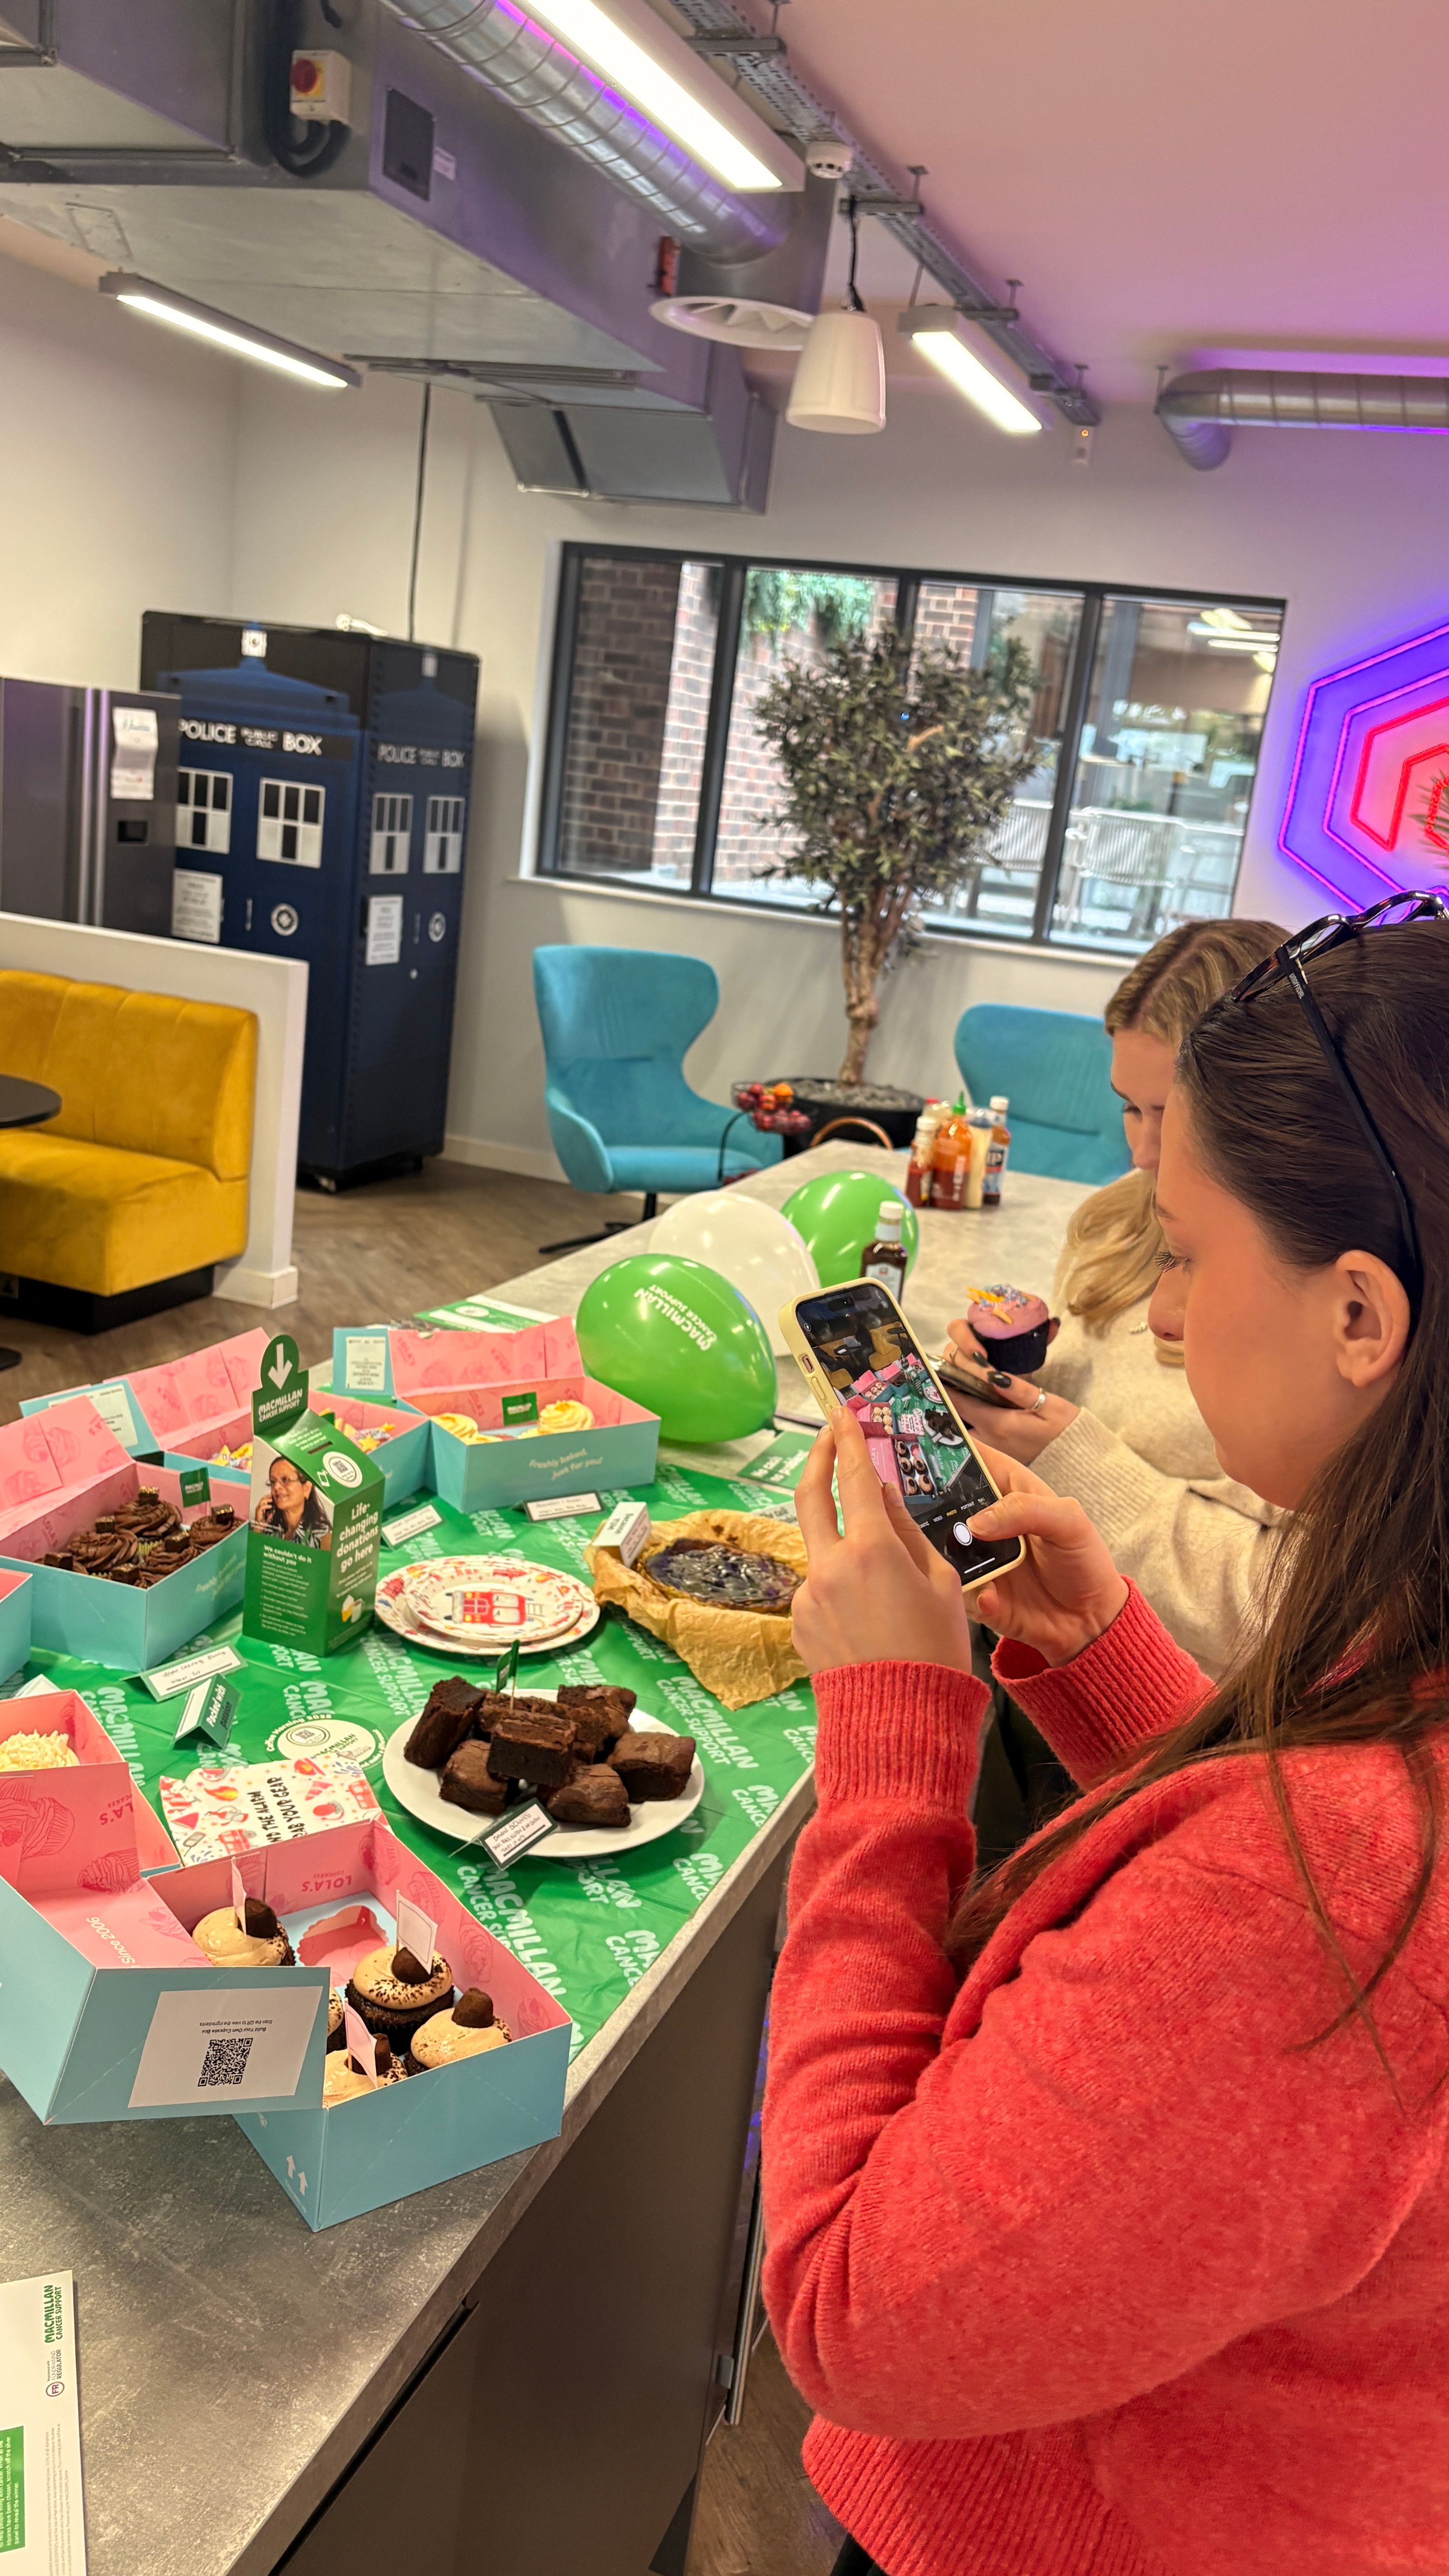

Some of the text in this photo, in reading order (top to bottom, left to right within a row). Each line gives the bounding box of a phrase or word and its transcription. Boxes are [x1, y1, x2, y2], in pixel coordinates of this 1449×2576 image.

[282, 731, 323, 756] BOX
[442, 749, 466, 768] BOX
[634, 1288, 711, 1350] MACMILLAN
[649, 1284, 717, 1343] CANCER SUPPORT
[258, 1388, 303, 1415] MACMILLAN
[259, 1398, 300, 1423] CANCER SUPPORT
[529, 1459, 559, 1469] Freshly
[570, 1461, 583, 1471] for
[351, 1502, 371, 1521] Life-
[339, 1511, 378, 1541] changing
[263, 1544, 273, 1552] We
[298, 1554, 307, 1562] do
[336, 1525, 379, 1558] donations
[263, 1552, 297, 1566] without you
[341, 1543, 373, 1573] go here
[206, 1684, 226, 1727] Packed with
[271, 1718, 306, 1738] Morning
[656, 1679, 731, 1766] CANCER SUPPORT
[671, 1676, 759, 1768] MACMILLAN
[267, 1776, 290, 1798] GEAR
[247, 1790, 270, 1814] ALARM
[276, 1799, 301, 1823] YOUR
[257, 1814, 279, 1831] THE
[301, 1875, 352, 1892] LOLA'S
[457, 1866, 497, 1921] CANCER
[86, 1917, 136, 1964] Since 2006
[476, 1861, 567, 1996] MACMILLAN
[44, 2285, 55, 2343] MACMILLAN
[52, 2383, 59, 2394] FR
